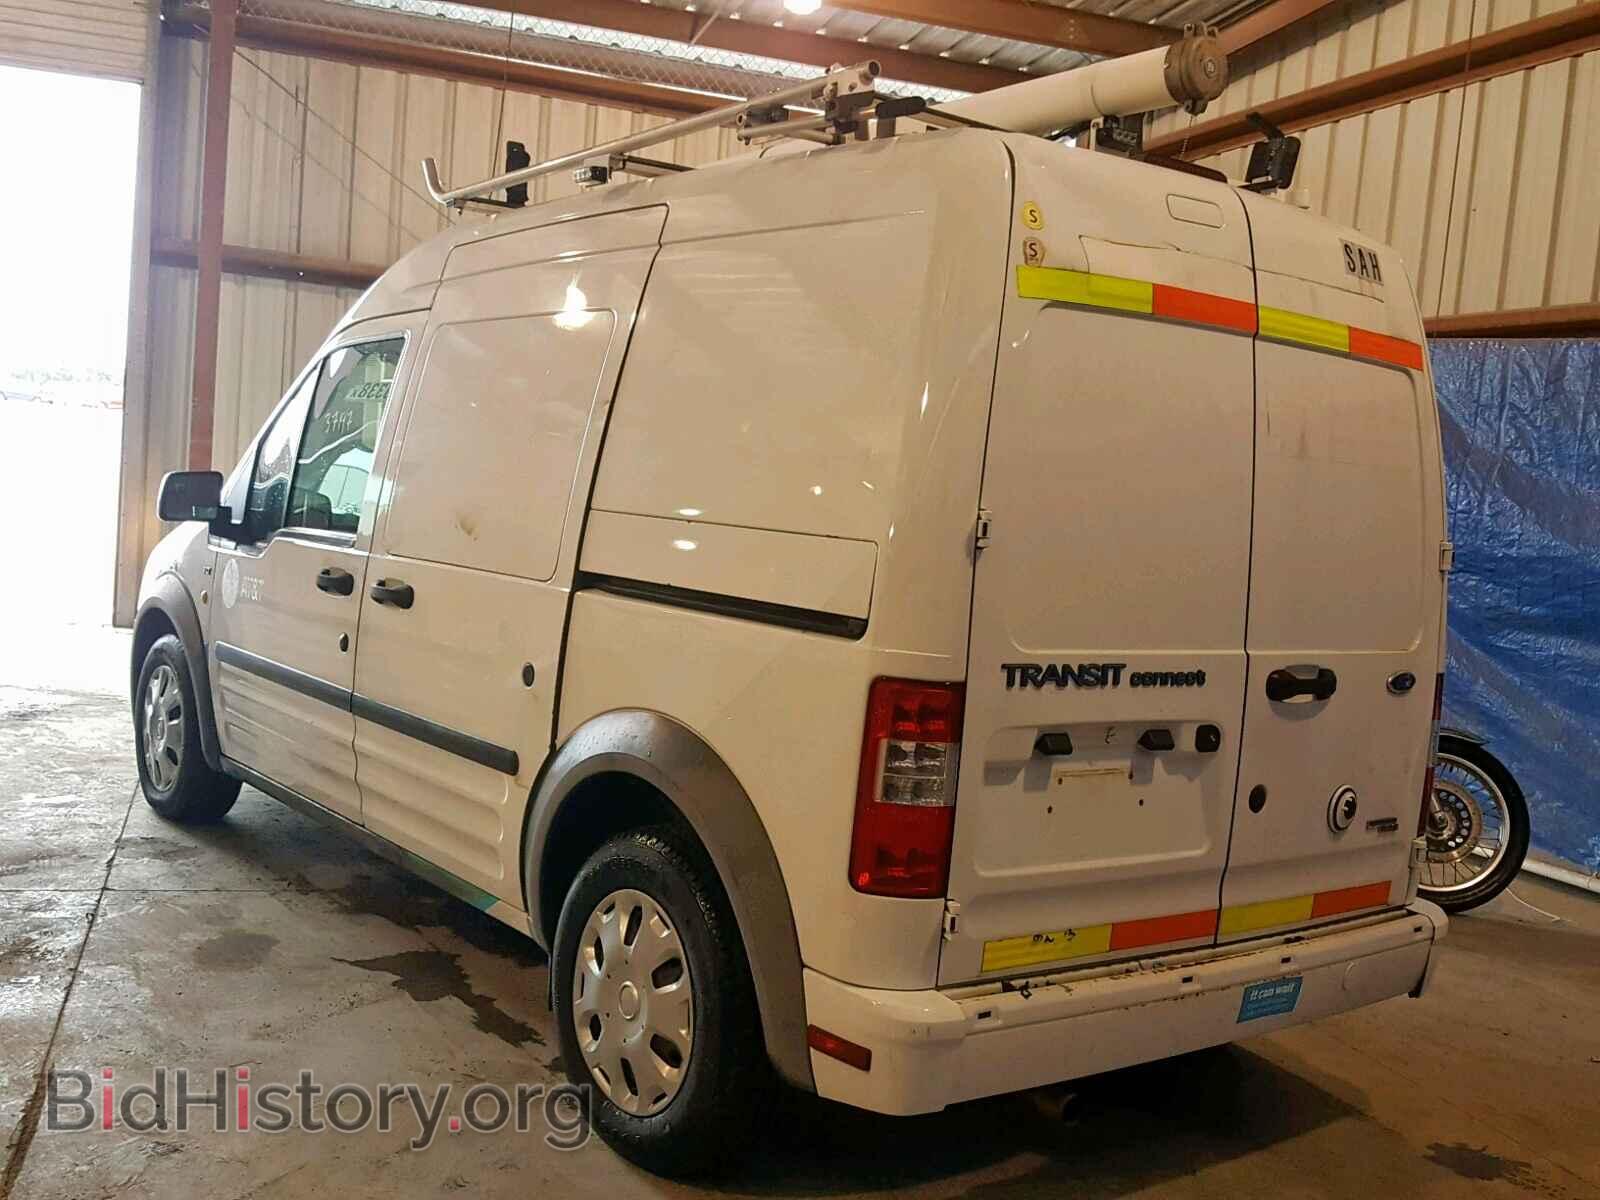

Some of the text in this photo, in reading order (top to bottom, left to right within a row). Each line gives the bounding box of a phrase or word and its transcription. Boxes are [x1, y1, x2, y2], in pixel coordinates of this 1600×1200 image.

[1028, 208, 1039, 224] S
[1028, 242, 1039, 258] S
[1343, 243, 1382, 282] SAH
[1001, 663, 1207, 690] TRANSIT connect
